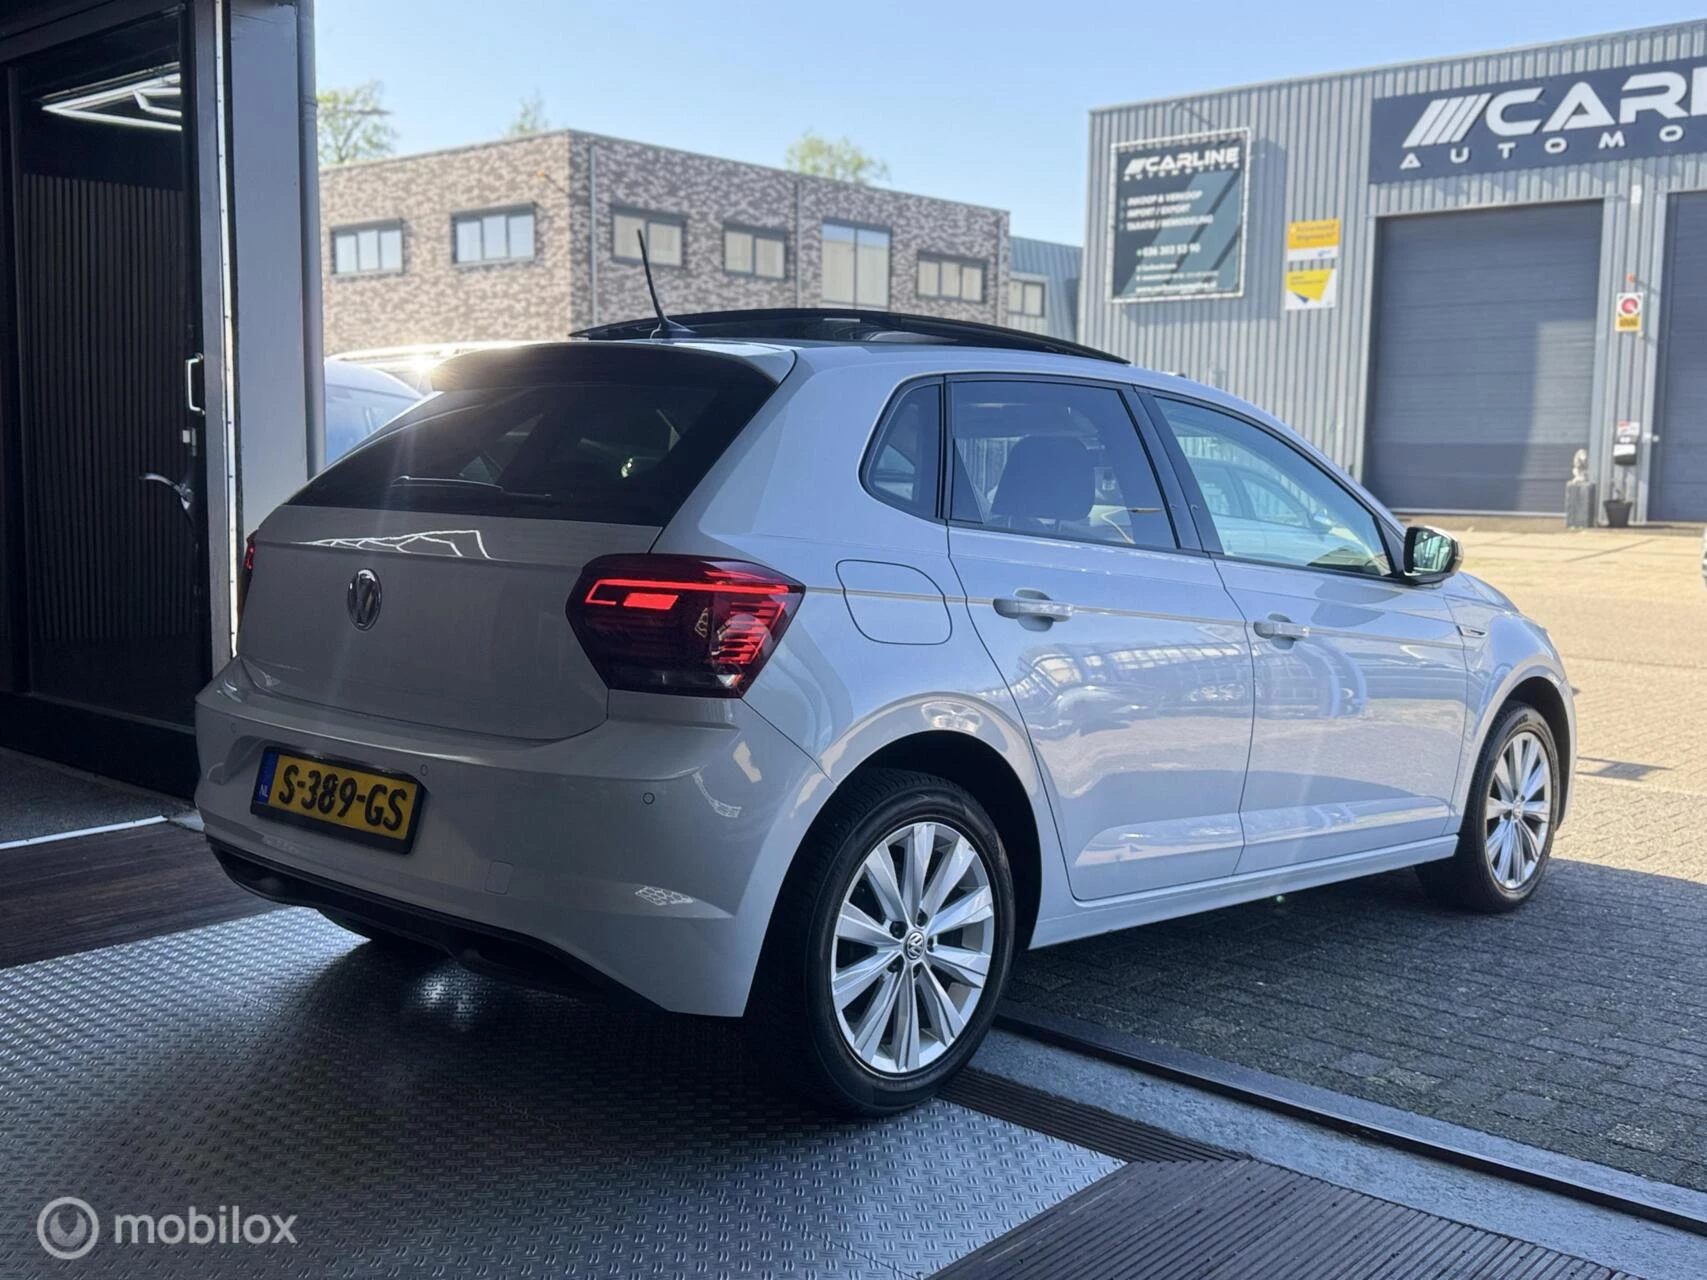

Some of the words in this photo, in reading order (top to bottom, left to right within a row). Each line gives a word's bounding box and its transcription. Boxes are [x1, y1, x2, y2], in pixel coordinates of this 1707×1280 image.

[1485, 66, 1707, 137] CAR
[1145, 147, 1240, 172] CARLINE
[1399, 124, 1684, 170] AUTOMO
[257, 783, 269, 798] NL
[278, 764, 408, 831] S-389-GS
